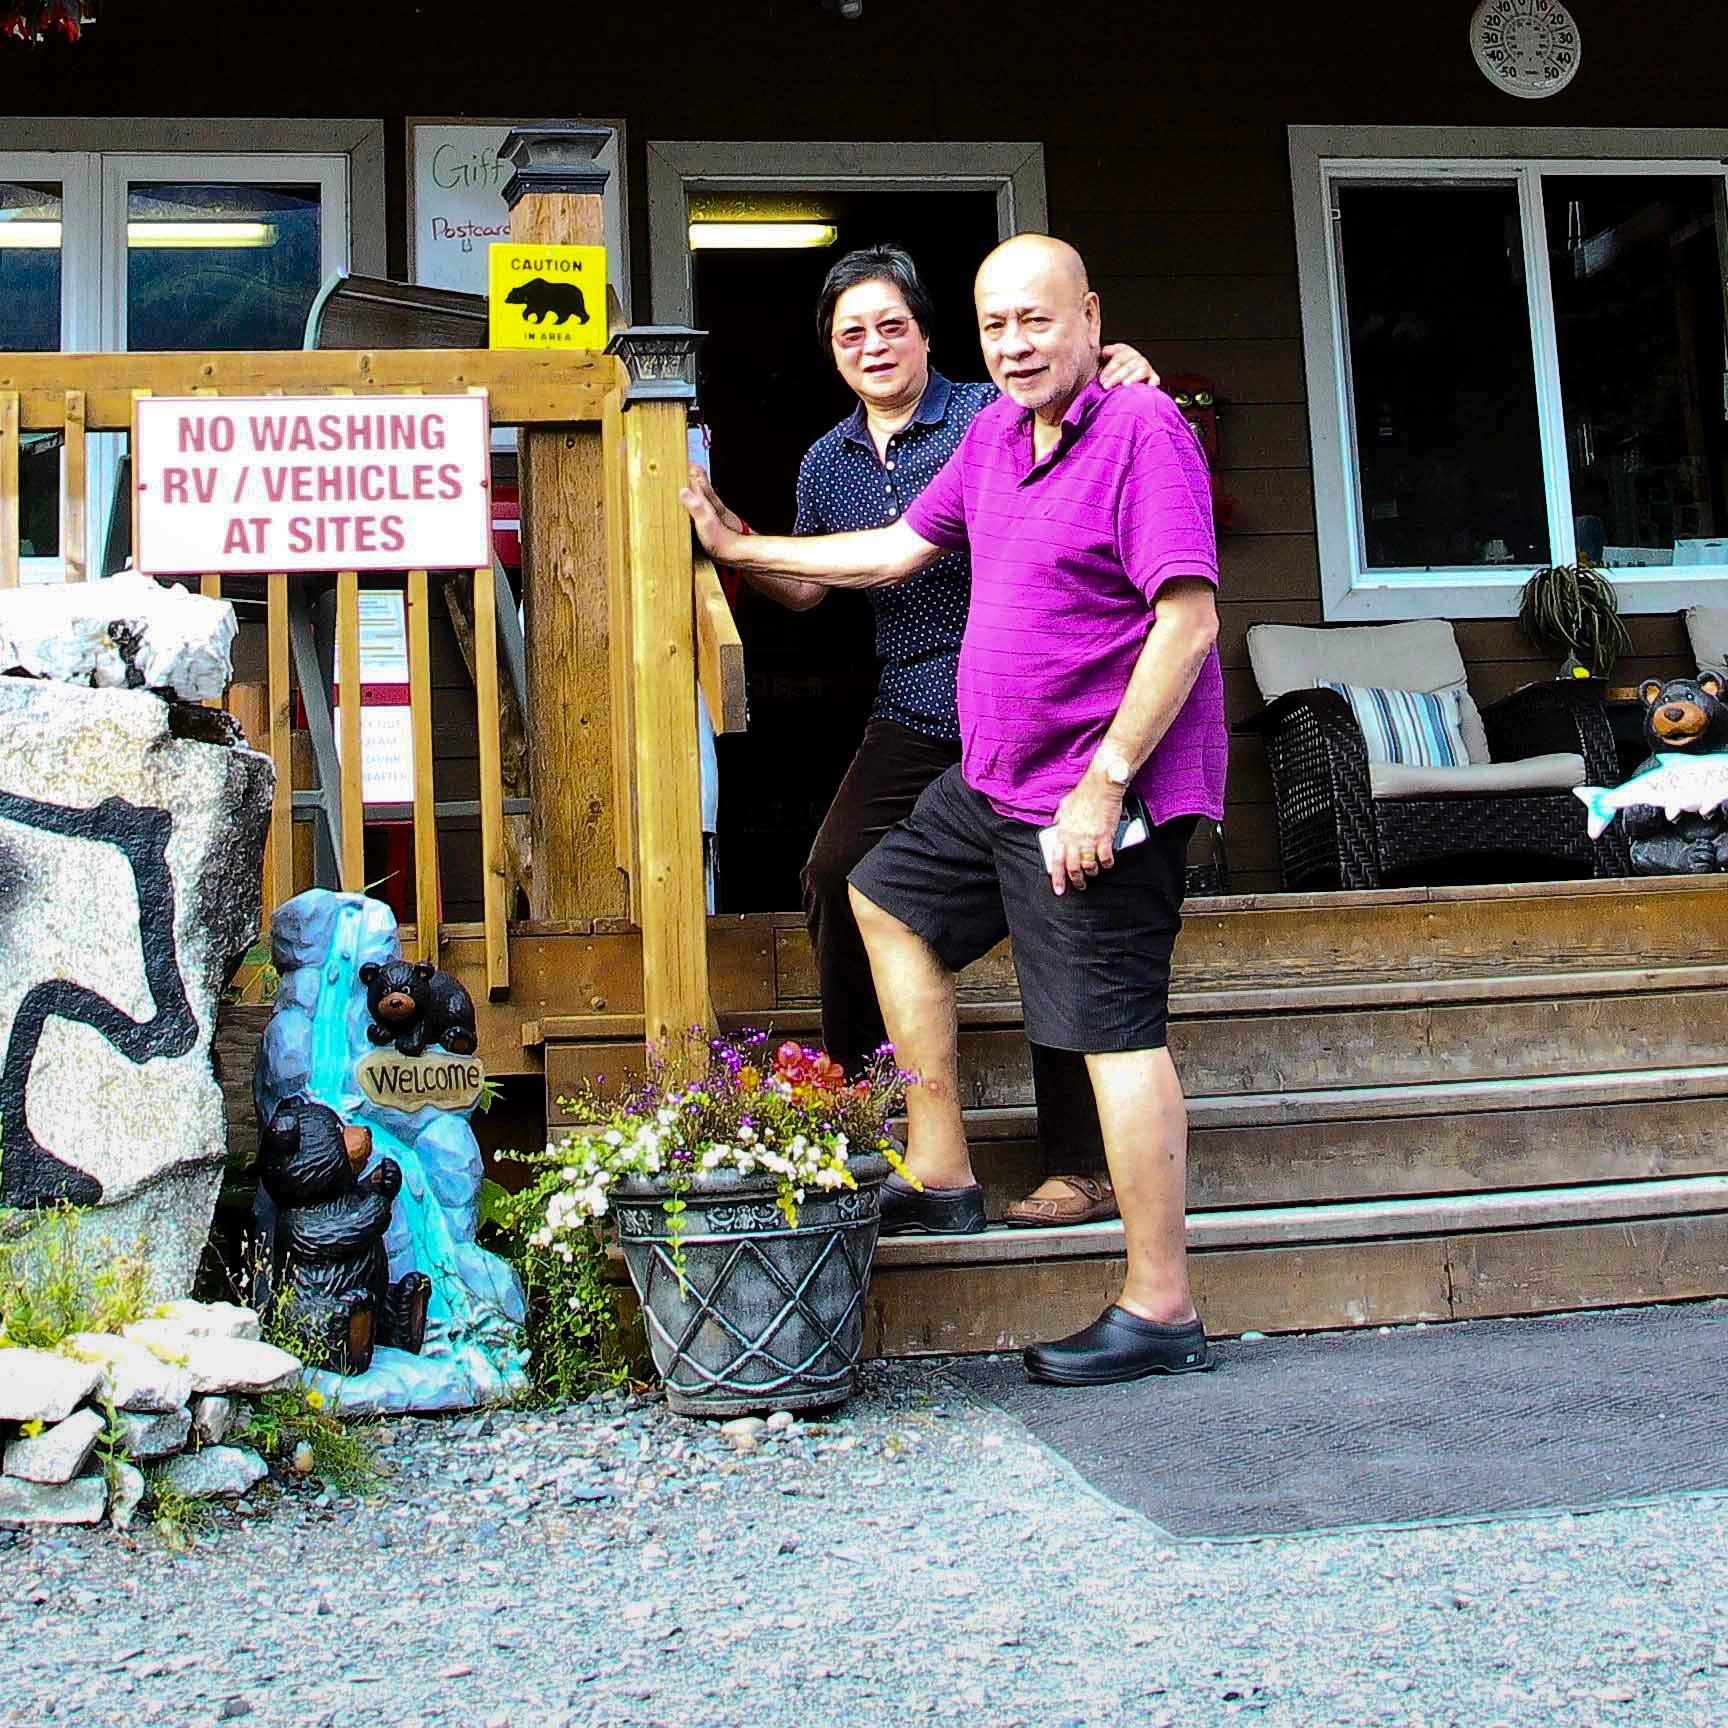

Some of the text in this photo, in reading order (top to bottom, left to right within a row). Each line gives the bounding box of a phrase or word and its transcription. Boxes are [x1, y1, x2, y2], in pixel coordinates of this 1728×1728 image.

[1535, 0, 1548, 11] 10
[1551, 14, 1564, 24] 20
[1559, 32, 1573, 44] 30
[1556, 52, 1572, 64] 40
[1544, 66, 1560, 78] 50
[511, 258, 583, 272] CAUTION
[524, 332, 573, 342] IN AREA
[179, 414, 445, 452] NO WASHING
[163, 463, 463, 503] RV / VEHICLES
[222, 515, 405, 553] AT SITES
[367, 1064, 480, 1095] Welcome
